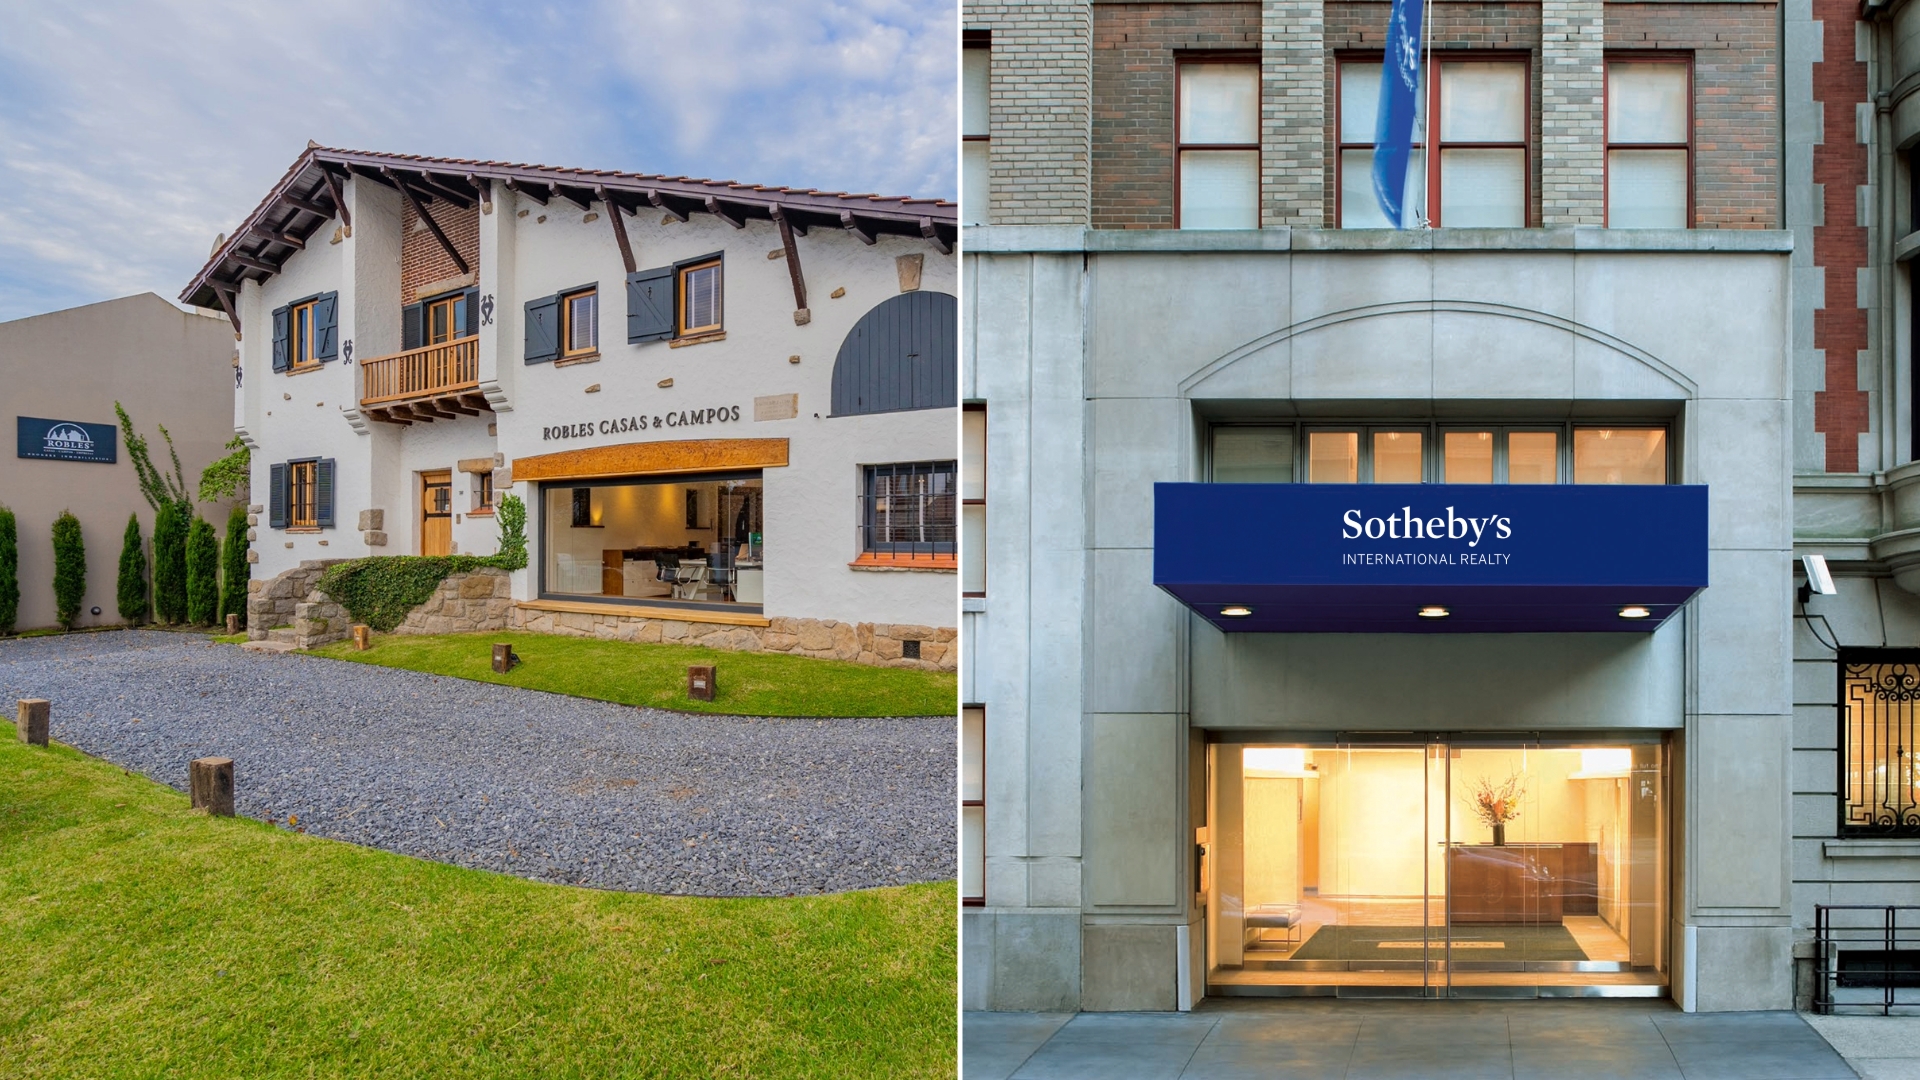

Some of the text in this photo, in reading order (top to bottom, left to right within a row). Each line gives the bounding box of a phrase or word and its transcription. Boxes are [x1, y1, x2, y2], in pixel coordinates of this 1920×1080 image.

[543, 423, 595, 440] ROBLES
[599, 415, 648, 434] CASAS
[653, 416, 663, 428] &
[665, 405, 740, 427] CAMPOS
[47, 440, 90, 449] ROBLES
[1342, 505, 1512, 548] Sotheby's
[1342, 553, 1511, 565] INTERNATIONAL REALTY
